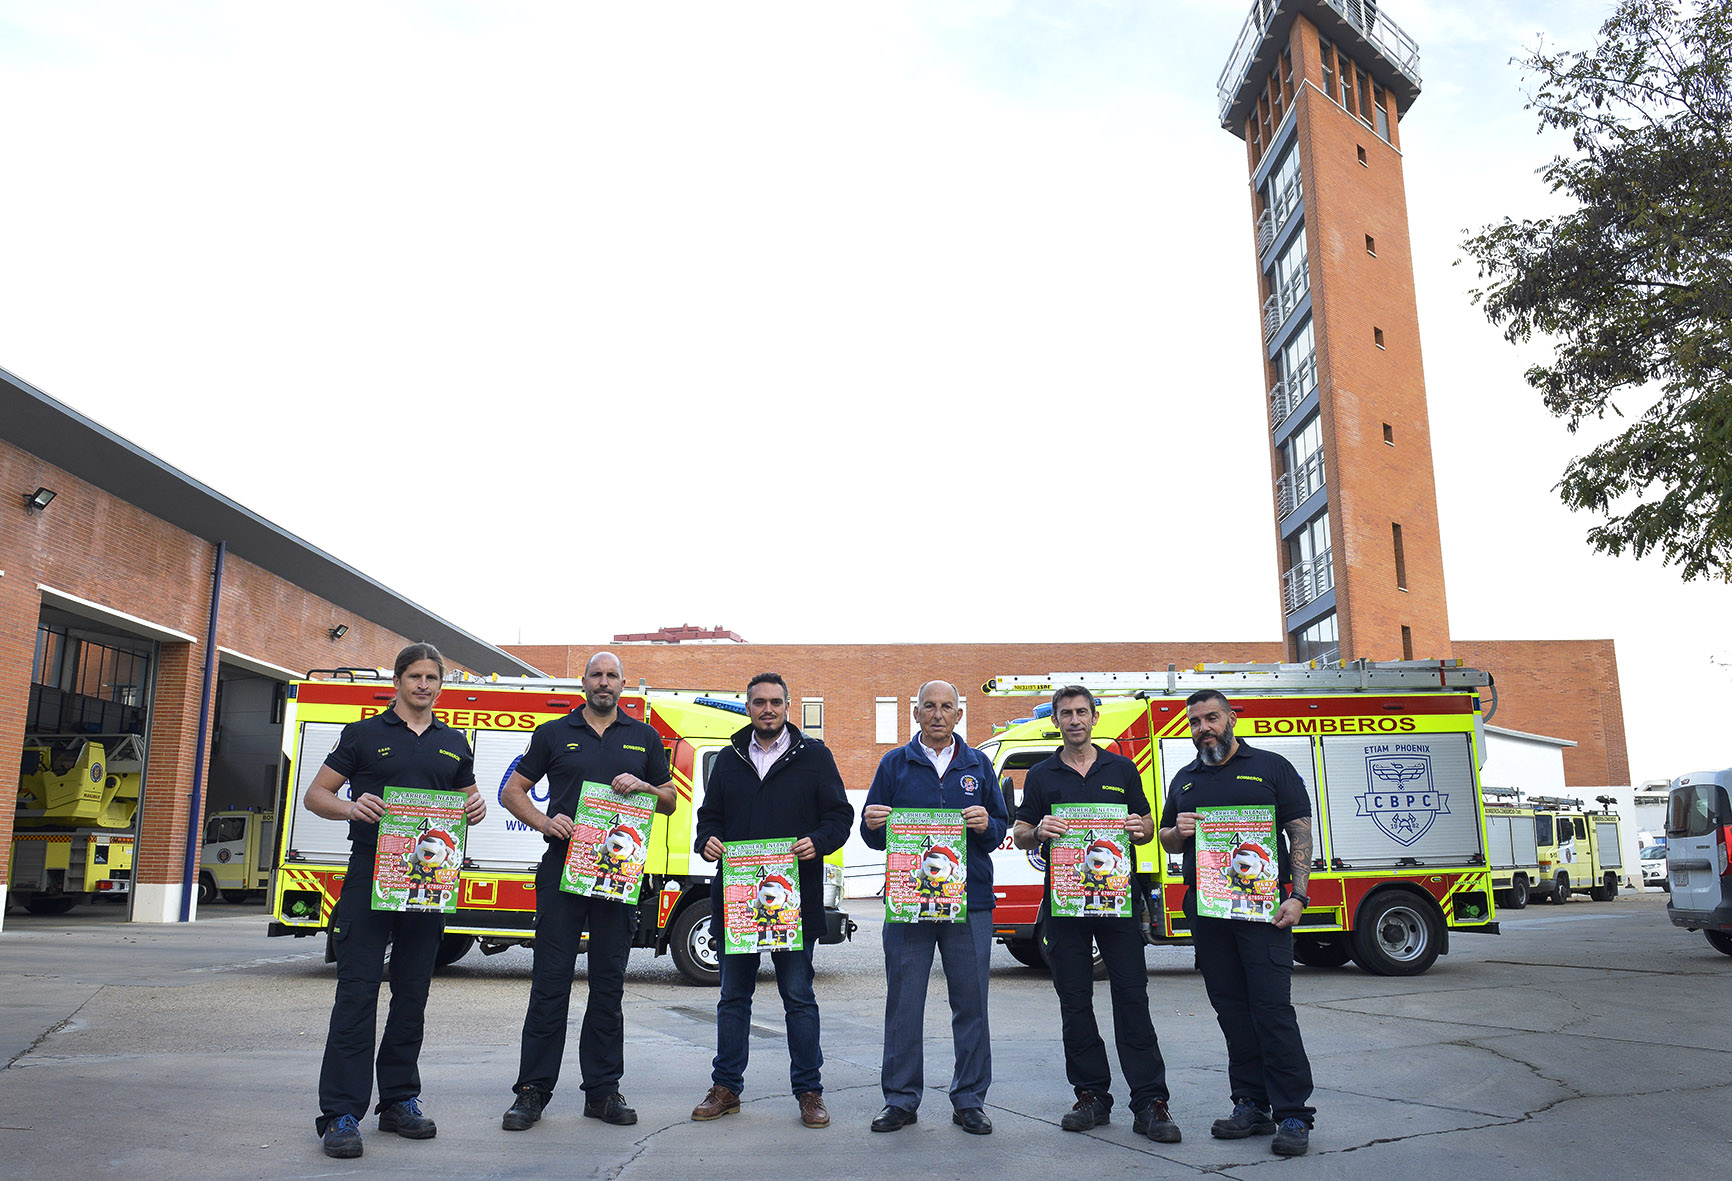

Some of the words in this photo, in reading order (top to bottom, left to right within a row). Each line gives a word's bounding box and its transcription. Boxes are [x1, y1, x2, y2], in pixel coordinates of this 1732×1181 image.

[361, 707, 535, 729] BBEROS
[1254, 717, 1416, 734] BOMBEROS
[439, 749, 461, 761] BOMBEROS
[623, 744, 646, 752] BOMBEROS
[1364, 745, 1389, 754] ETIAM
[1396, 744, 1430, 753] PHOENIX
[400, 791, 431, 799] CARRERA
[1102, 785, 1125, 794] BOMBEROS
[416, 817, 430, 834] 4
[607, 812, 621, 828] 4
[920, 835, 932, 850] 4
[1083, 829, 1095, 844] 4
[1229, 832, 1241, 847] 4
[755, 865, 766, 880] 4
